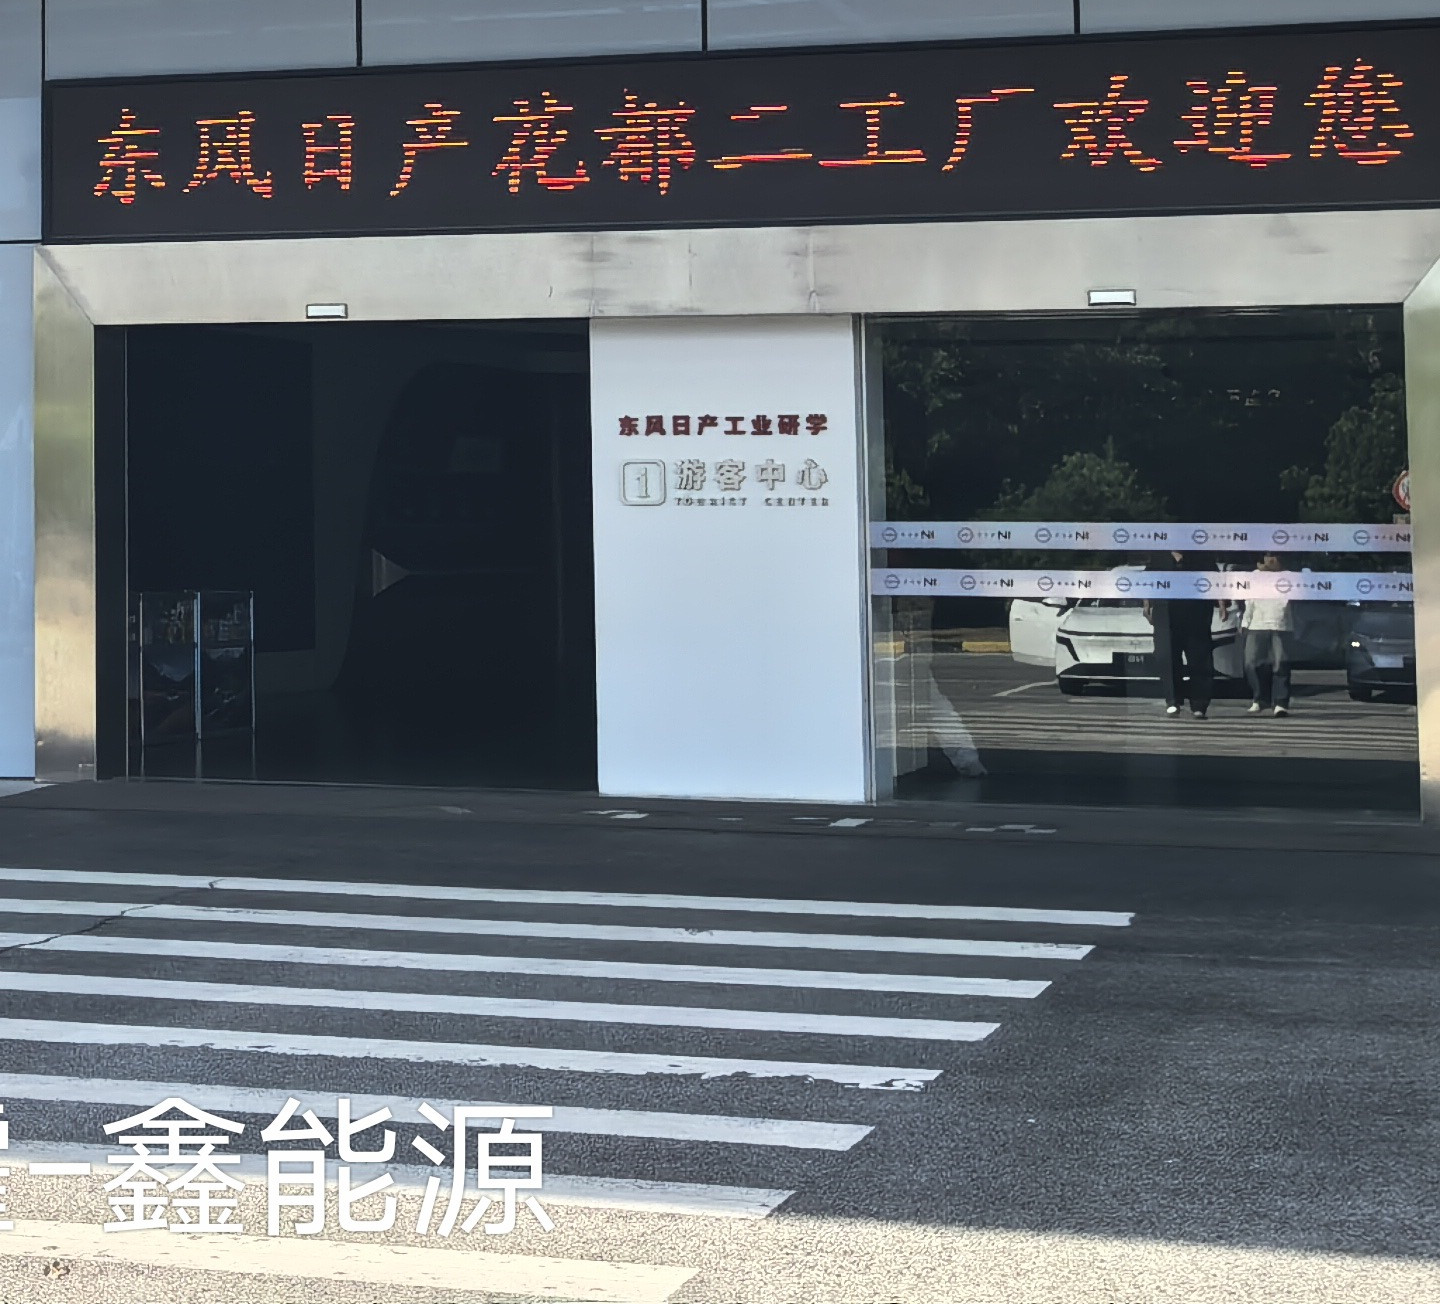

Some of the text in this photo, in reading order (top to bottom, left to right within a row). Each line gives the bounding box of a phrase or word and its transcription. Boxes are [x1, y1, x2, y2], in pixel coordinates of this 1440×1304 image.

[92, 60, 1416, 203] 东风日产花都二工厂欢迎您
[618, 413, 829, 437] 东风日产工业研学
[674, 458, 830, 492] 游客中心
